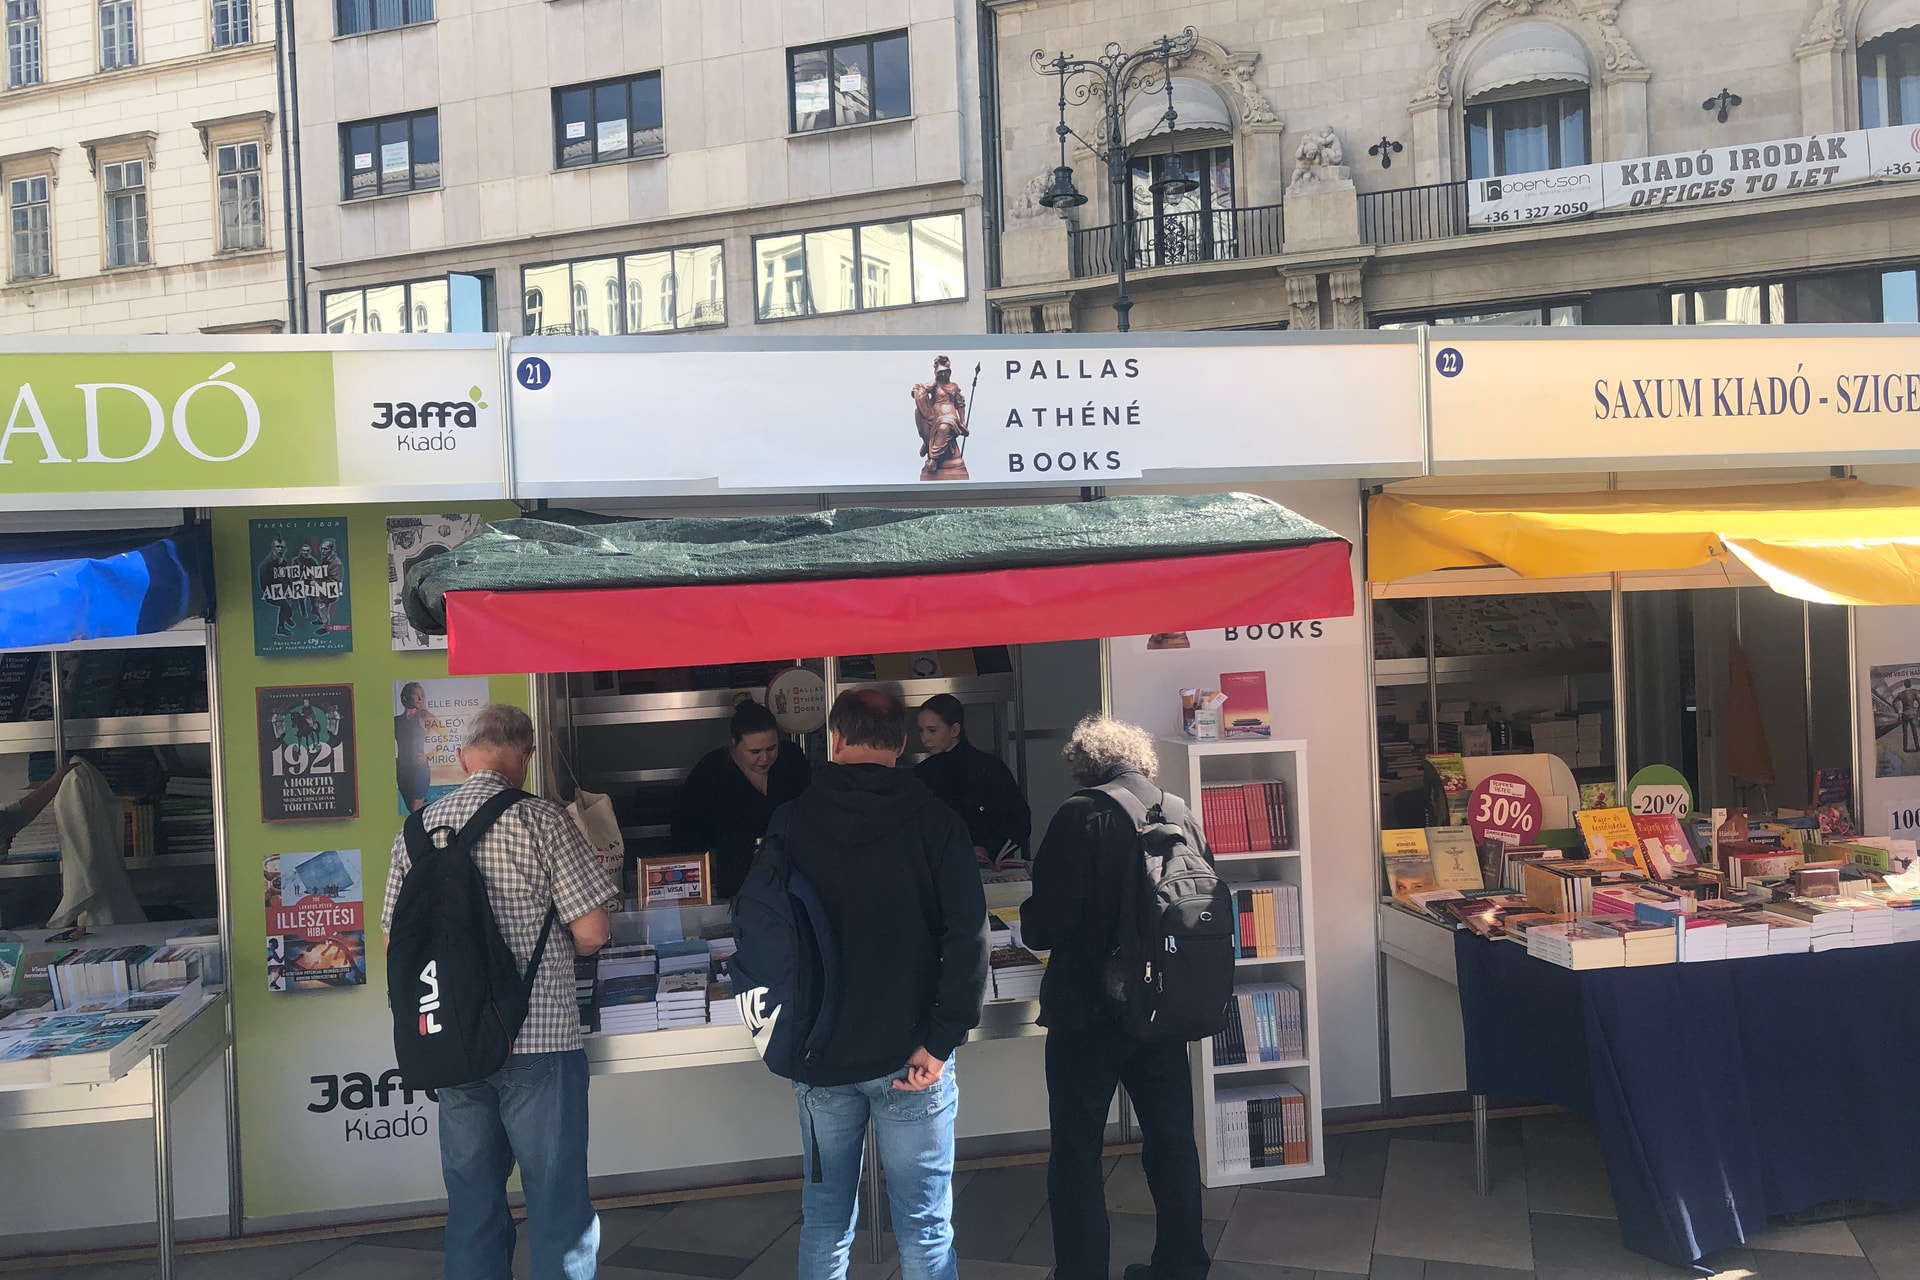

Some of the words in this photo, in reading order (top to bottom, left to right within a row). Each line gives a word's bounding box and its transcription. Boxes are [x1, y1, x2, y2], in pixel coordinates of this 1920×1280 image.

[1621, 149, 1713, 185] KIADÓ
[1729, 135, 1848, 171] IRODÁK
[1883, 162, 1911, 176] +36
[1487, 173, 1591, 197] robertson
[1629, 178, 1733, 207] OFFICES
[1745, 173, 1778, 194] TO
[1787, 165, 1840, 188] LET
[1484, 210, 1509, 223] +36
[1513, 209, 1520, 220] 1
[1525, 206, 1549, 219] 327
[1553, 201, 1589, 216] 2050
[524, 362, 543, 385] 21
[1005, 358, 1140, 380] PALLAS
[1441, 353, 1458, 372] 22
[1593, 377, 1702, 420] SAXUM
[1712, 363, 1812, 417] KIADÓ
[1836, 373, 1920, 415] SZIGE
[0, 361, 261, 464] ADÓ
[1005, 400, 1141, 428] ATHÉNÉ
[396, 428, 457, 452] Kiadó
[1008, 450, 1121, 473] BOOKS
[1225, 620, 1324, 642] BOOKS
[428, 700, 451, 708] ELLE
[454, 699, 479, 708] RUSS
[271, 741, 347, 777] 1921
[282, 786, 335, 797] RENDSZER
[290, 776, 334, 788] HORTHY
[1476, 793, 1533, 832] 30%
[1633, 793, 1688, 815] -20%
[276, 905, 355, 930] ILLESZTÉSI
[307, 927, 327, 937] HIBA
[419, 960, 443, 1036] FILA
[735, 986, 770, 1031] IKE
[307, 1068, 440, 1113] Jaff
[345, 1105, 428, 1142] Kiadó
